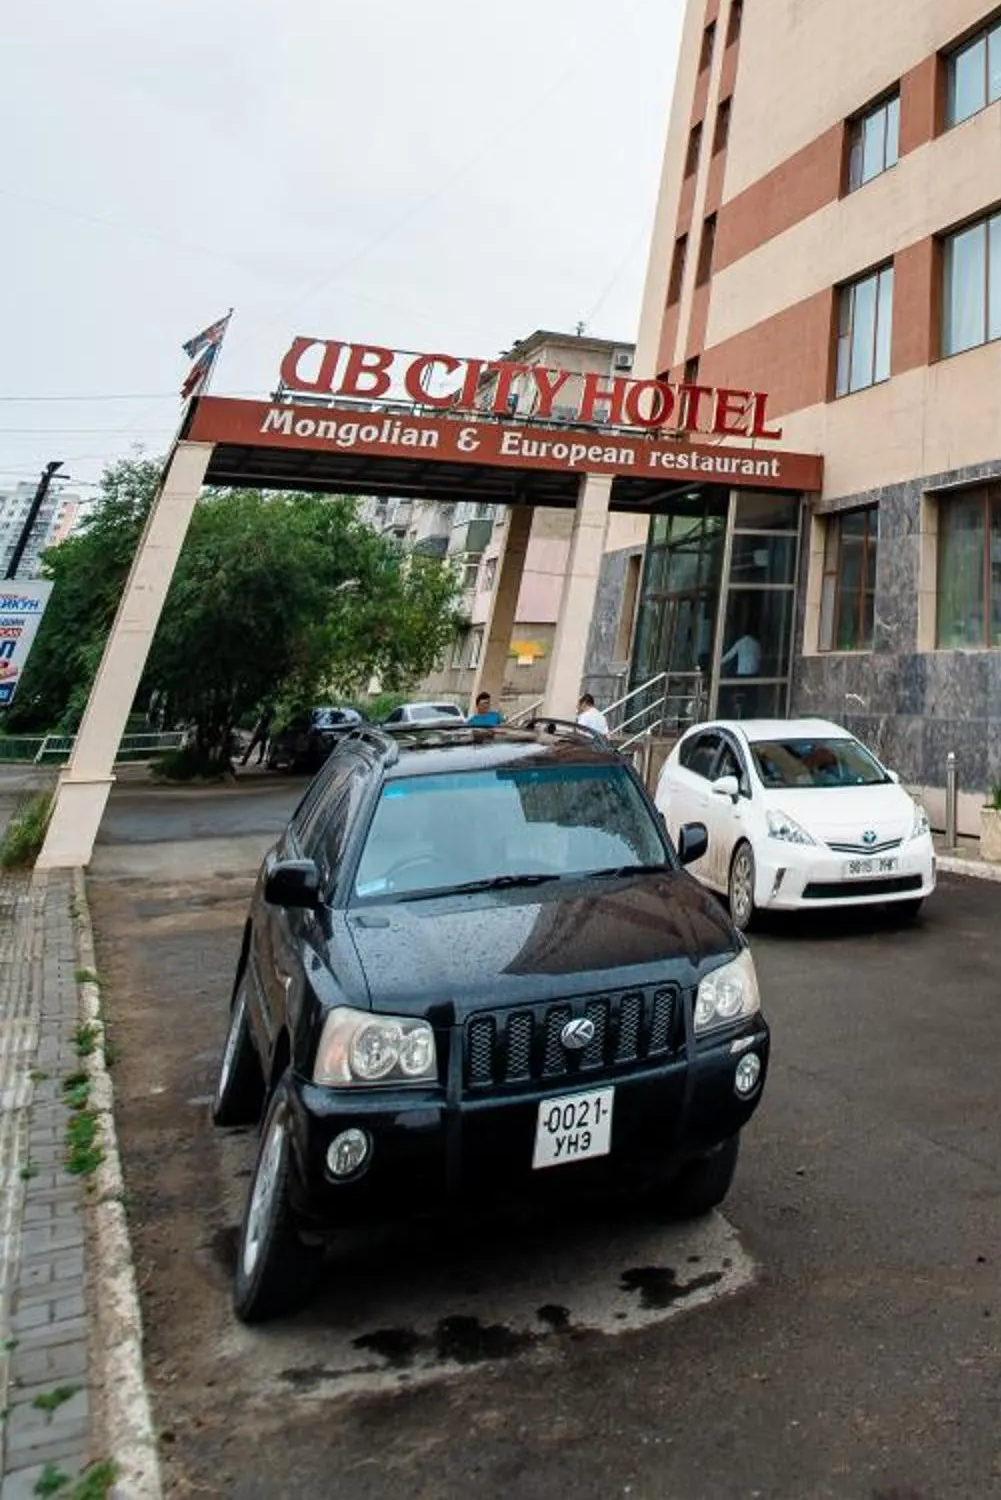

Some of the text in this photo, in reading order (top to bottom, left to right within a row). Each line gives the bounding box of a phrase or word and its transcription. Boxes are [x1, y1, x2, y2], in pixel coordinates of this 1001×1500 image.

[280, 336, 783, 440] UB CITY HOTEL
[260, 407, 781, 477] Mongolian & European restaurant
[547, 1097, 601, 1133] 0021
